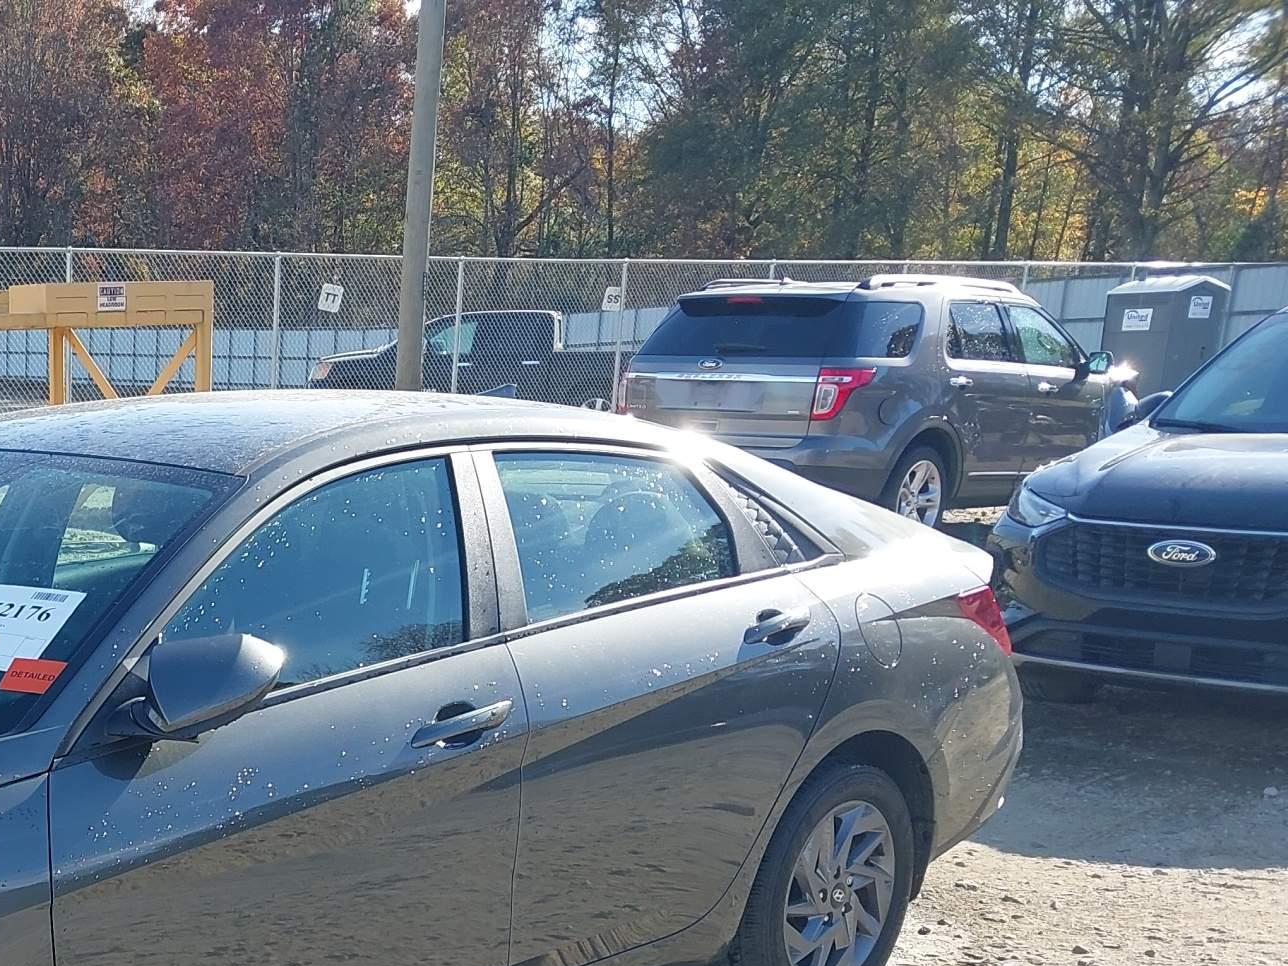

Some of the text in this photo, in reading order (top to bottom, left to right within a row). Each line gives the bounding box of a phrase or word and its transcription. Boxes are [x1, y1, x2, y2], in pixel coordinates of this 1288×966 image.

[99, 287, 124, 295] CAUTION
[325, 292, 338, 303] TT
[607, 294, 621, 304] SS
[1161, 544, 1200, 561] Ford
[10, 670, 56, 682] DETAILED
